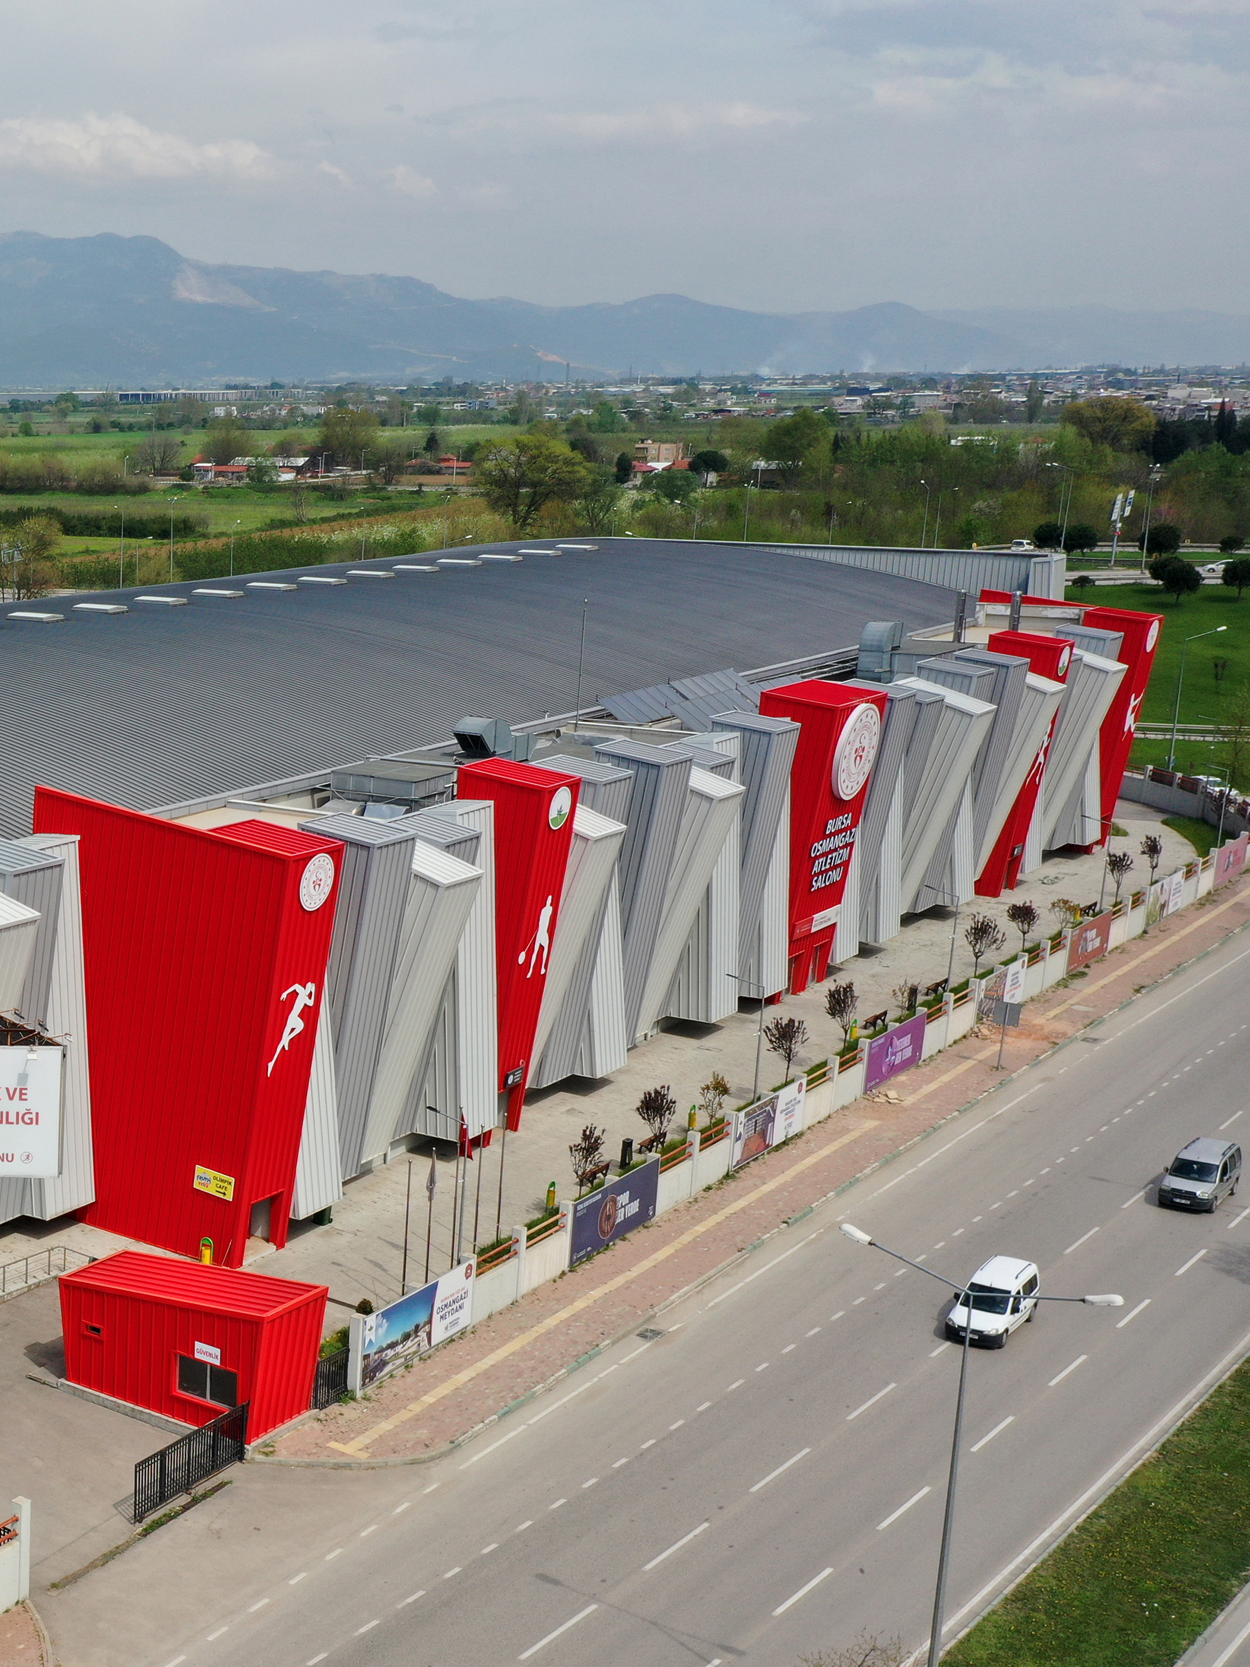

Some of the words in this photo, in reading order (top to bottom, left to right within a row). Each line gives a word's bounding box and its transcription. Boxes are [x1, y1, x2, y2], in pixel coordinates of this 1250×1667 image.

[826, 812, 852, 835] BURSA
[811, 846, 850, 875] ATLETİZM
[810, 866, 844, 892] SALONU
[5, 1087, 28, 1102] VE
[215, 1183, 228, 1192] CAFE
[436, 1288, 469, 1315] OSMANGAZİ
[439, 1302, 465, 1323] MEYDANI
[195, 1347, 219, 1360] GÜVENLİK
